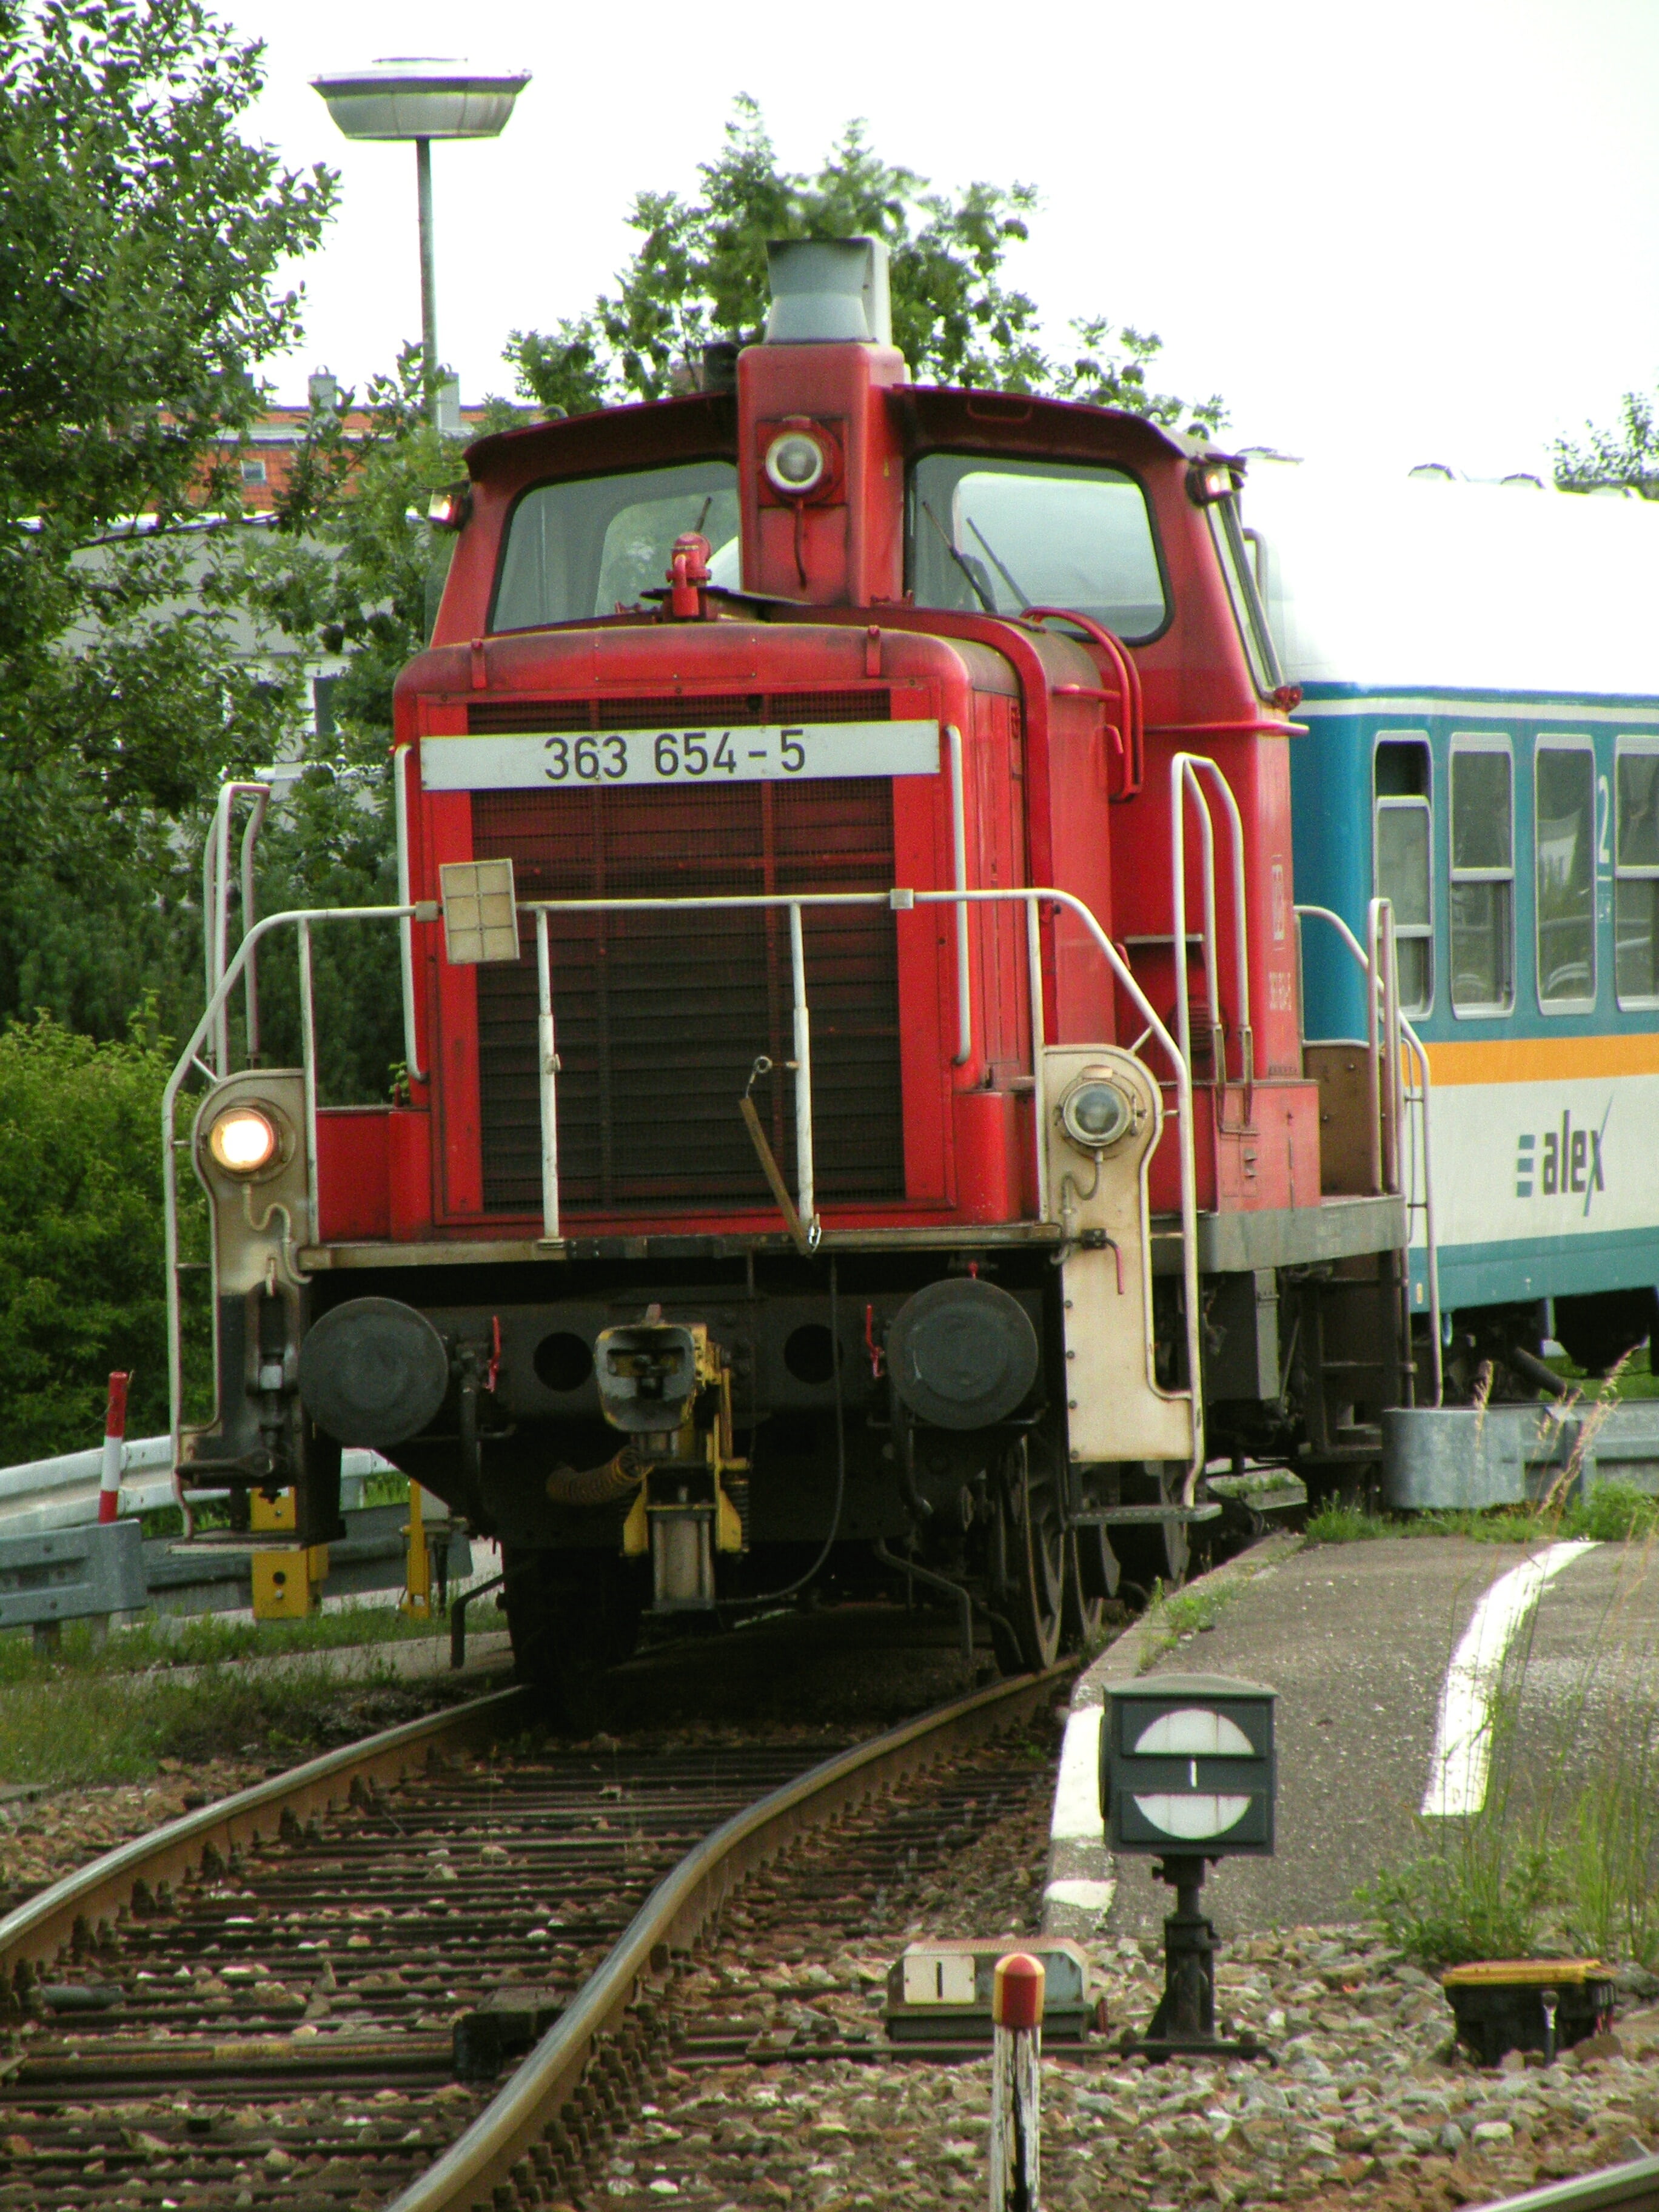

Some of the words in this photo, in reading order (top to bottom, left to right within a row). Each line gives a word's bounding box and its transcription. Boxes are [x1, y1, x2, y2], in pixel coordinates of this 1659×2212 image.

[545, 736, 628, 780] 363
[1598, 775, 1610, 863] 2
[1542, 1093, 1614, 1217] alex
